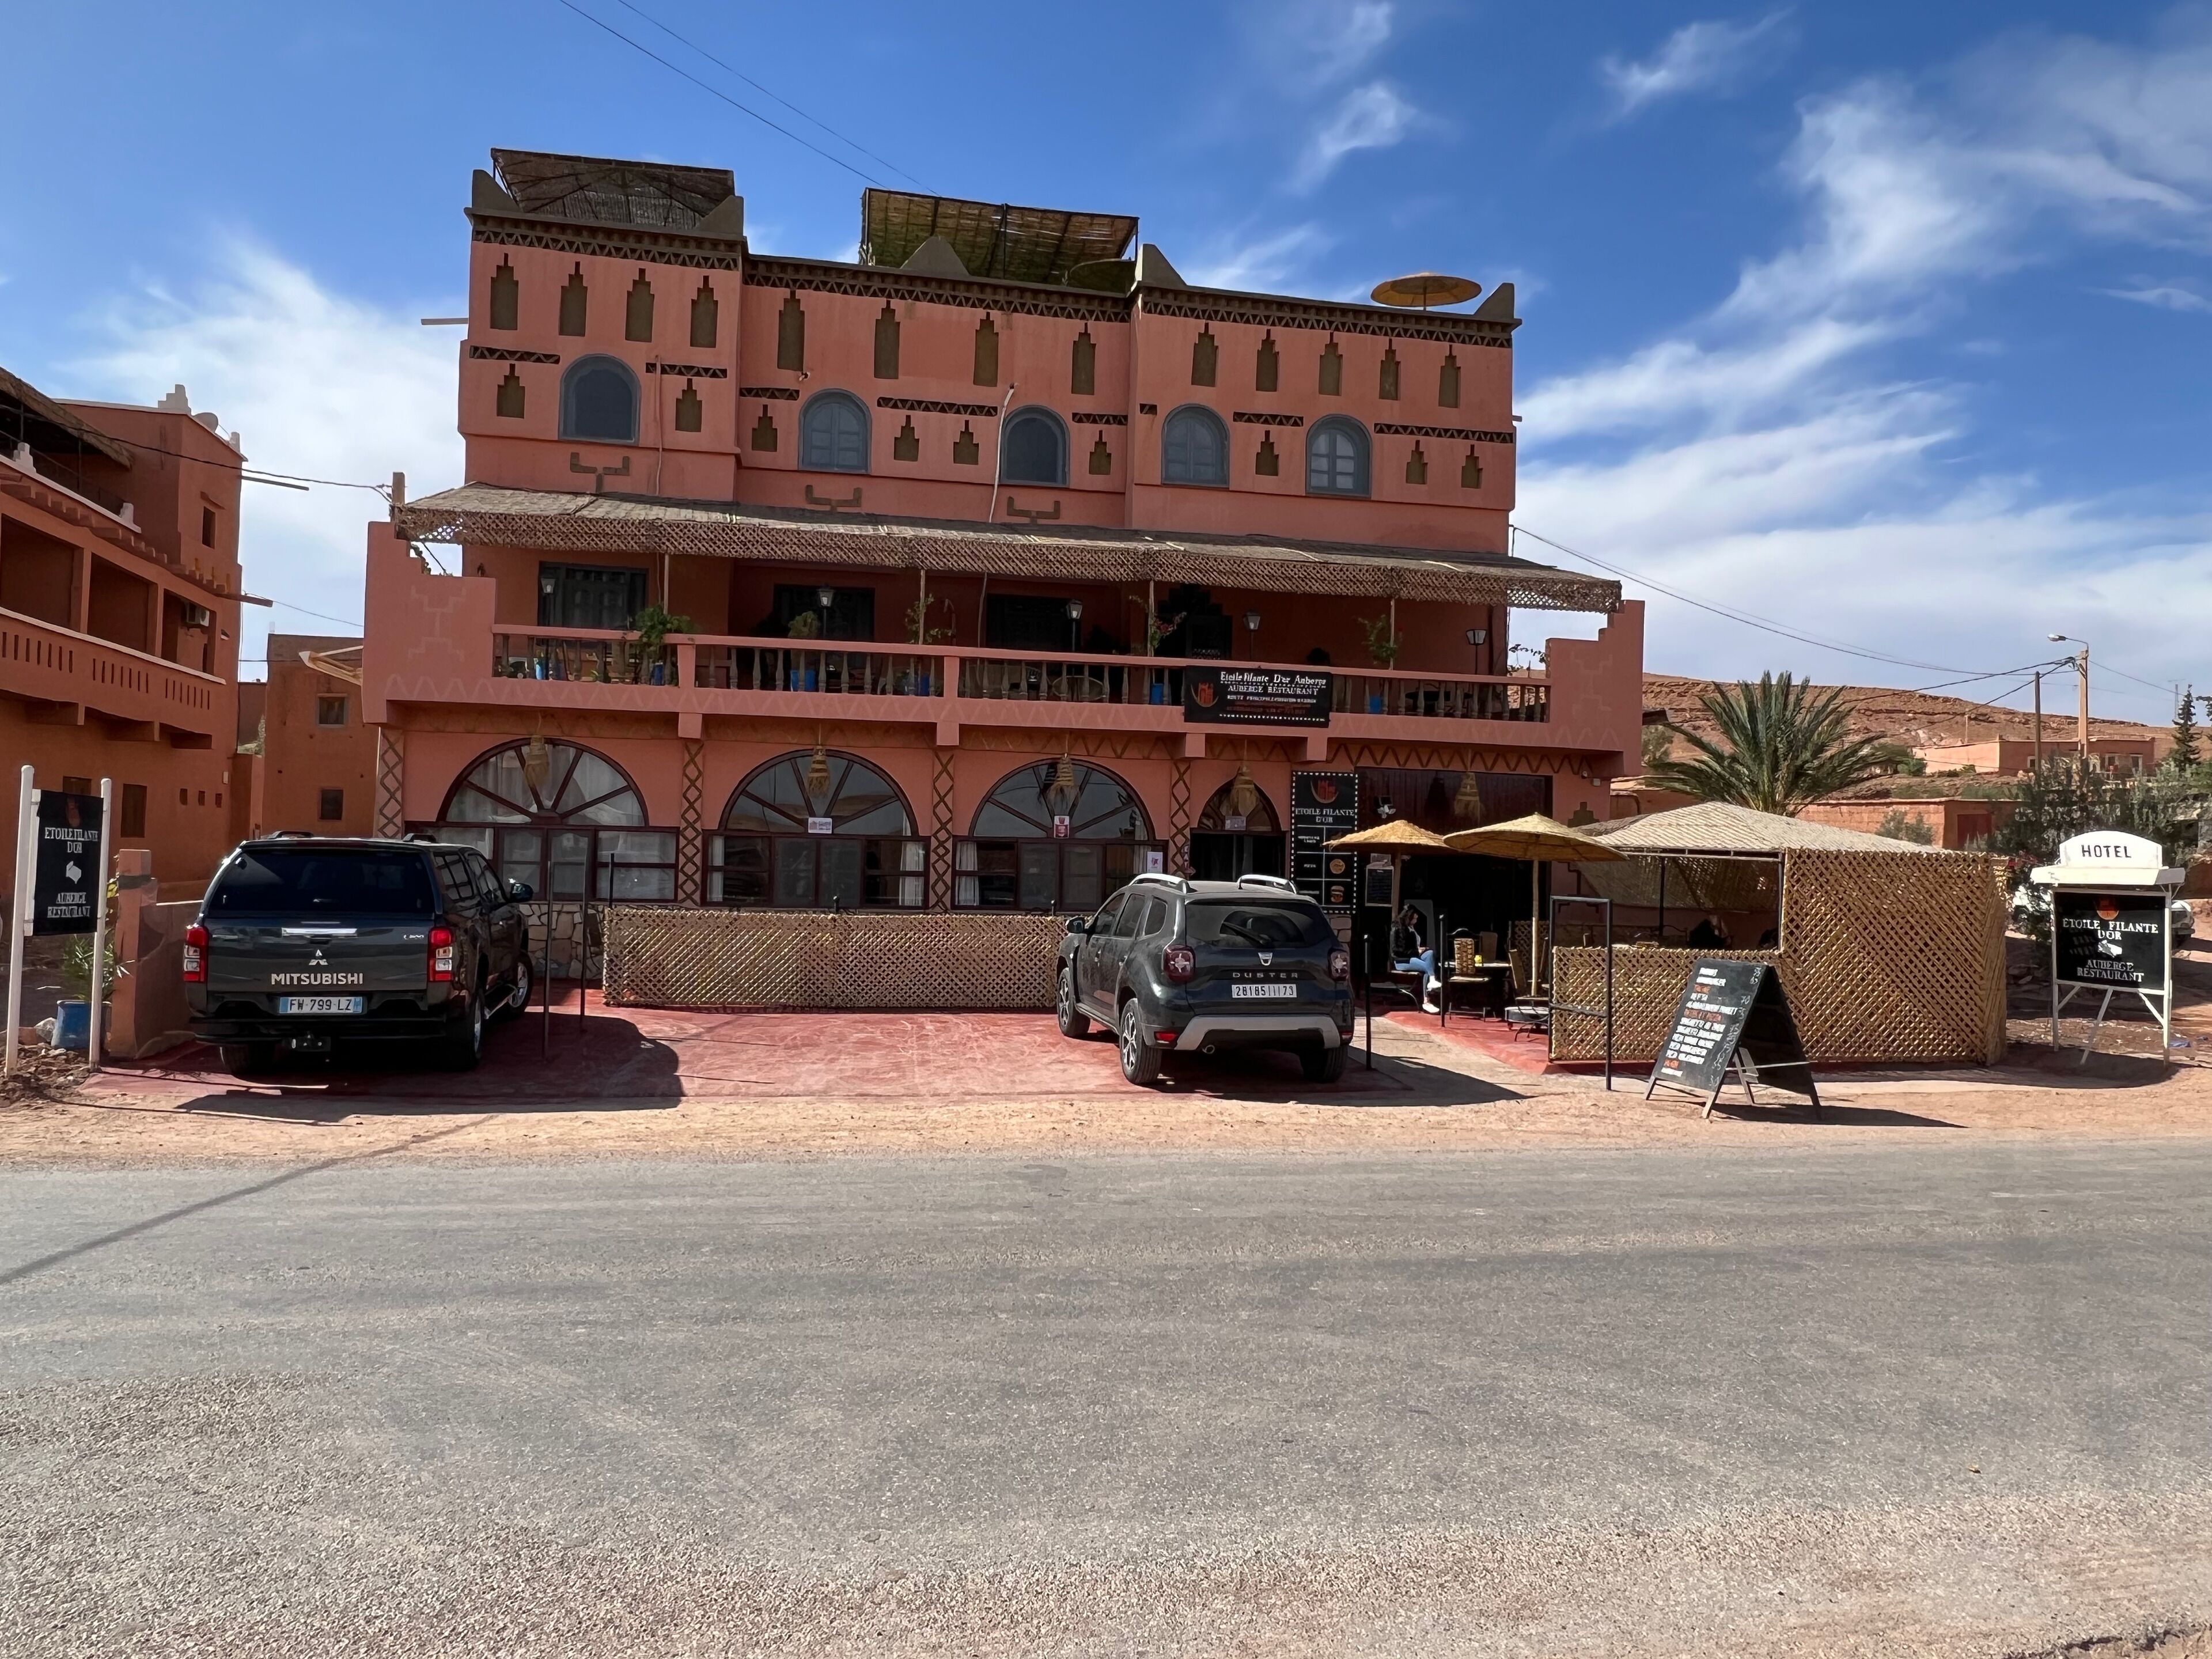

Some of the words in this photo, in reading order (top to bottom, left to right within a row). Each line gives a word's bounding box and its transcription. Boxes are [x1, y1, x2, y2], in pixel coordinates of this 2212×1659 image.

[1268, 687, 1319, 695] RESTAURANT
[2081, 844, 2132, 858] HOTEL
[2063, 918, 2100, 929] ETOILE
[2109, 921, 2158, 934] FILANTE
[2085, 959, 2134, 971] AUBERGE
[271, 973, 363, 985] MITSUBISHI
[2077, 967, 2145, 982] RESTAURANT
